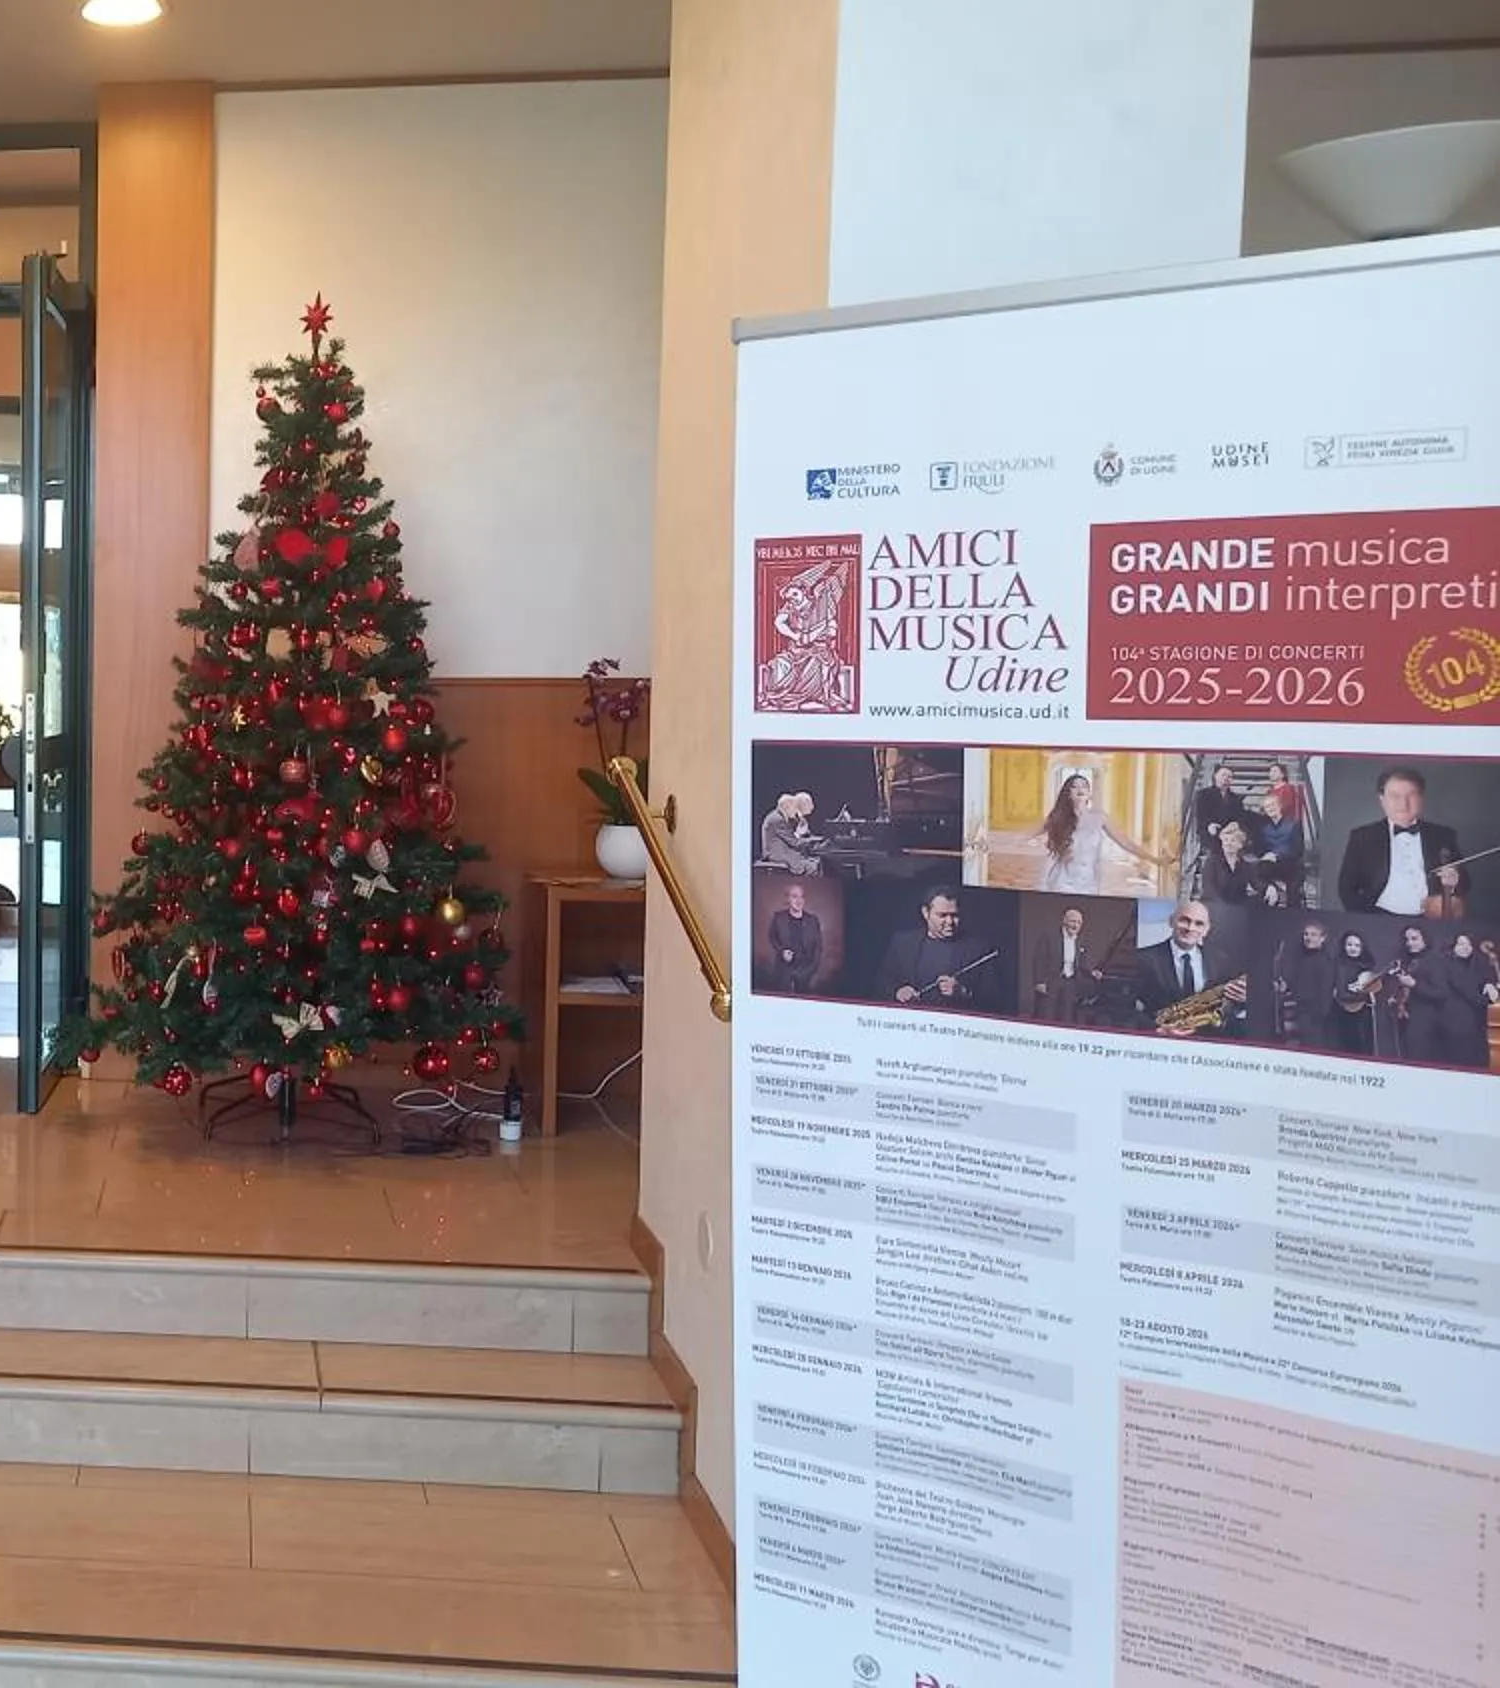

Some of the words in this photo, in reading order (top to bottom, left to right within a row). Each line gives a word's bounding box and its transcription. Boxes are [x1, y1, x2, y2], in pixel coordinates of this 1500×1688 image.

[1212, 441, 1269, 456] UDINE
[962, 455, 1055, 472] FONDAZIONE
[1130, 454, 1177, 464] COMUNE
[1212, 454, 1269, 469] MUSEI
[838, 463, 901, 475] MINISTERO
[1130, 467, 1141, 476] DI
[1143, 465, 1175, 475] UDINE
[838, 477, 867, 486] DELLA
[962, 473, 1005, 488] FRIULI
[837, 485, 901, 499] CULTURA
[868, 528, 1019, 570] AMICI
[1110, 537, 1275, 574] GRANDE
[1287, 528, 1450, 567] musica
[868, 571, 1036, 611] DELLA
[1110, 581, 1270, 615] GRANDI
[1286, 570, 1499, 620] interpreti
[868, 613, 1069, 651] MUSICA
[1150, 644, 1238, 661] STAGIONE
[1244, 645, 1263, 661] DI
[1269, 644, 1364, 661] CONCERTI
[946, 655, 1069, 693] Udine
[1426, 649, 1485, 690] 104
[1109, 666, 1365, 706] 2025-2026
[868, 703, 1070, 719] www.amicimusica.ud.it
[1105, 1044, 1120, 1056] per
[1171, 1052, 1187, 1064] che
[1273, 1064, 1297, 1077] stata
[1360, 1073, 1385, 1087] 1922
